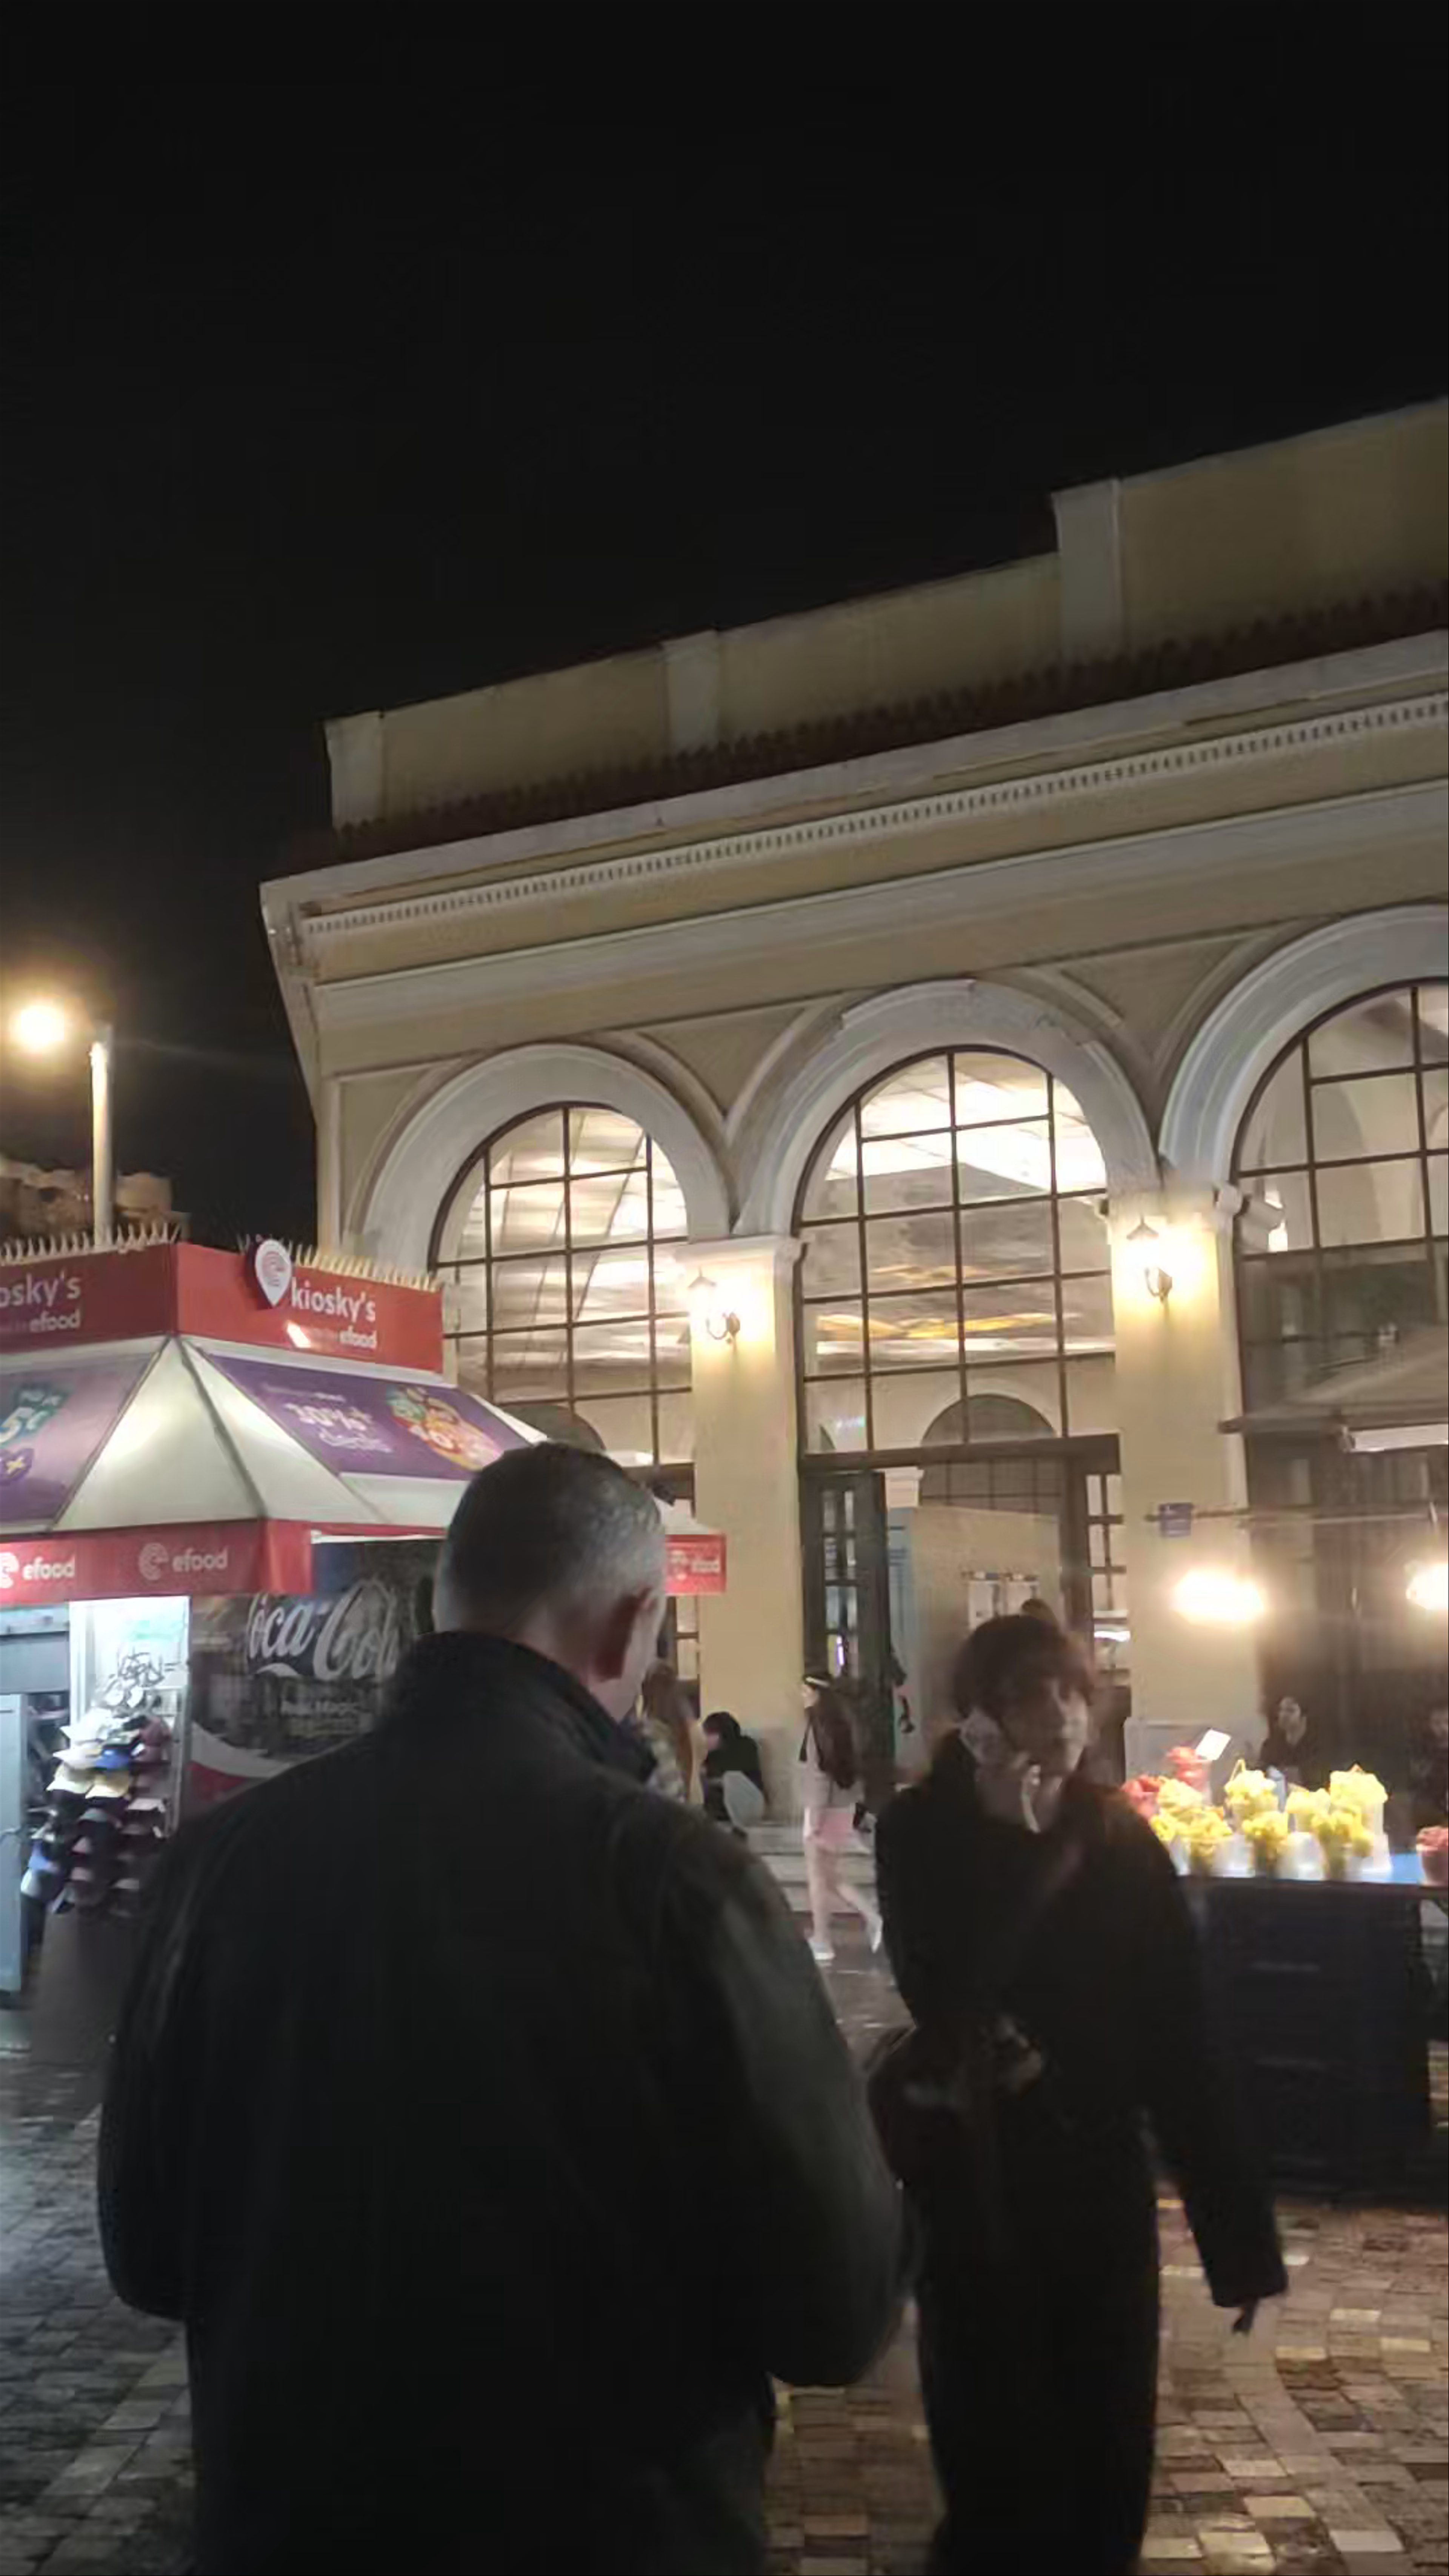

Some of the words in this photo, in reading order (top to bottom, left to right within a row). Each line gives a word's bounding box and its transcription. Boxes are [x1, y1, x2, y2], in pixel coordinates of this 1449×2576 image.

[292, 1276, 376, 1323] kiosky's
[29, 1309, 80, 1333] efood
[22, 1555, 75, 1580] efood
[172, 1546, 228, 1572] efood
